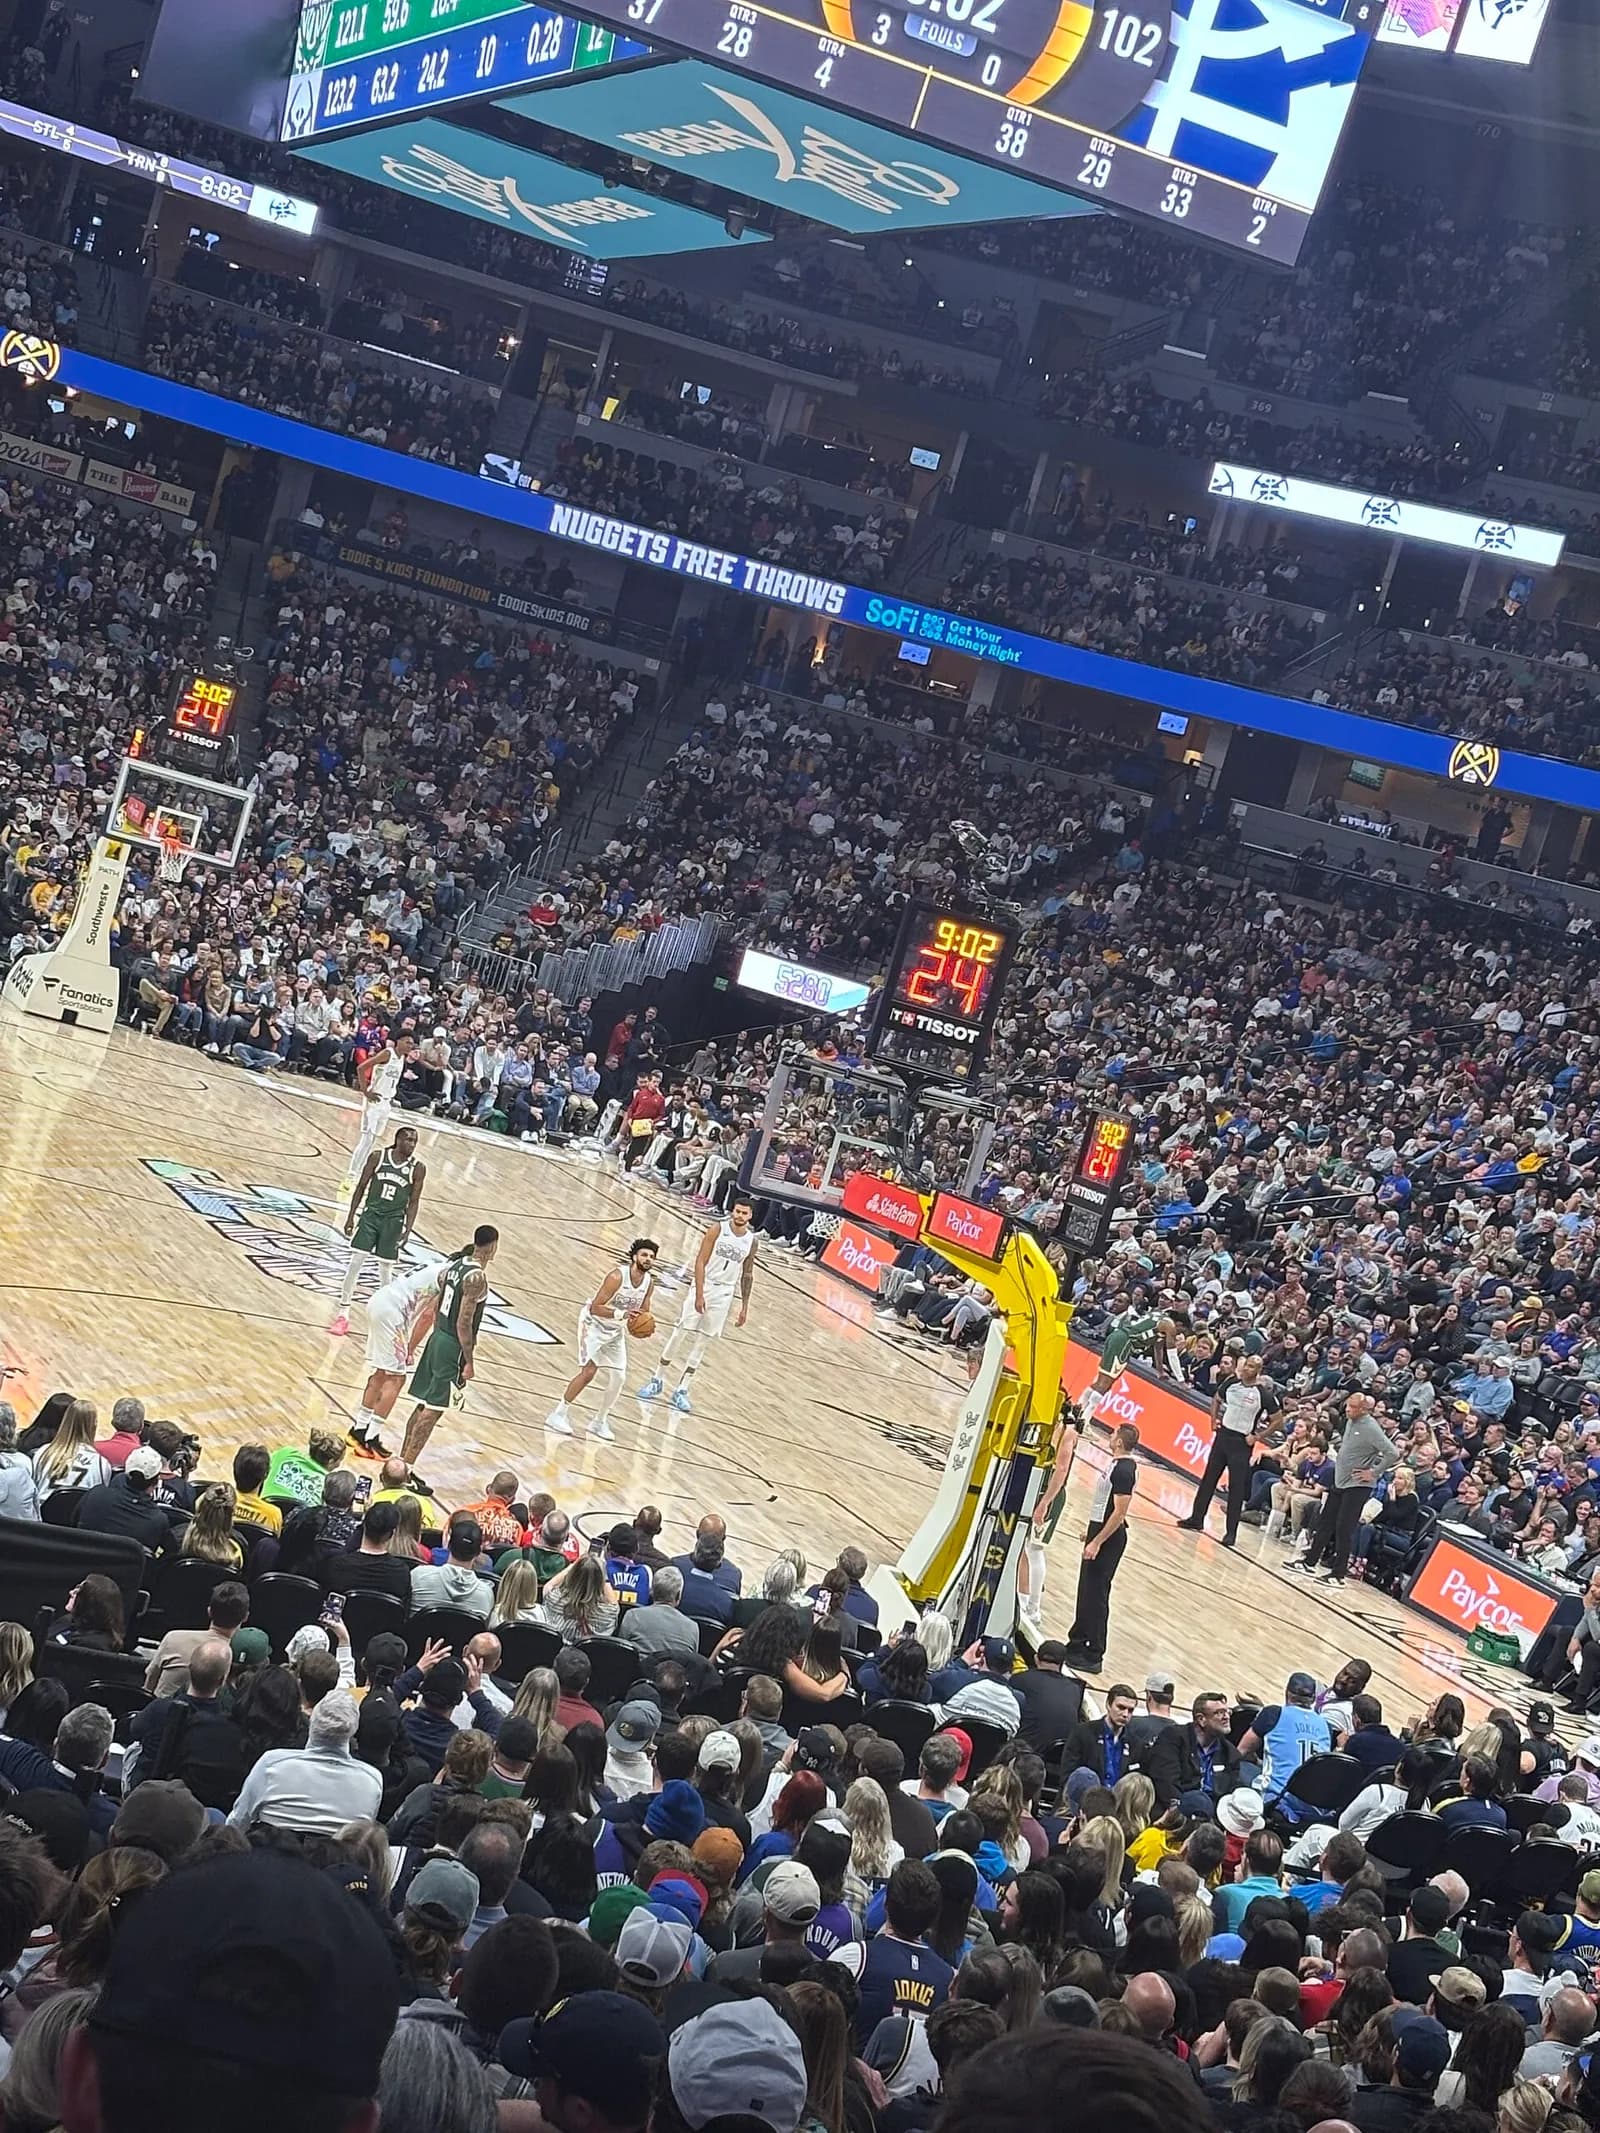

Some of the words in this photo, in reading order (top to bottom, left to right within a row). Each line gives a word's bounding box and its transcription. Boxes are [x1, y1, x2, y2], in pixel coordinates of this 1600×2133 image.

[335, 3, 369, 49] 121.1
[729, 4, 757, 25] QTR3
[871, 13, 893, 45] 3
[1357, 6, 1369, 19] 8
[716, 21, 752, 58] 28
[818, 35, 846, 58] QTR4
[919, 19, 964, 51] FOULS
[1100, 13, 1164, 68] 102
[323, 74, 357, 117] 123.2
[370, 61, 399, 105] 63.2
[417, 48, 450, 93] 24.2
[475, 34, 497, 79] 10
[527, 15, 564, 65] 0.28
[814, 57, 832, 88] 4
[981, 54, 1002, 86] 0
[1006, 105, 1033, 126] QTR1
[1089, 136, 1116, 157] QTR2
[1171, 166, 1198, 187] QTR3
[1251, 195, 1278, 216] QTR4
[995, 122, 1029, 159] 38
[1077, 152, 1112, 189] 29
[1160, 182, 1193, 218] 33
[1246, 214, 1267, 245] 2
[0, 441, 41, 466] oors
[90, 468, 118, 486] THE
[160, 491, 188, 508] BAR
[549, 504, 668, 565] NUGGETS
[673, 537, 738, 585] FREE
[742, 560, 848, 614] THROWS
[338, 547, 384, 572] EDDIE'S
[386, 559, 414, 579] KIDS
[416, 568, 491, 603] FOUNDATION
[497, 592, 591, 632] EDDIESKIDS.ORG
[865, 598, 920, 634] SoFi
[949, 620, 972, 636] Get
[975, 626, 1003, 644] Your
[945, 631, 989, 656] Money
[192, 679, 233, 706] 9:02
[175, 694, 224, 734] 24
[181, 732, 222, 750] TISSOT
[86, 889, 109, 946] Southwest
[934, 920, 999, 964] 9:02
[60, 984, 114, 1008] Fanatics
[775, 963, 833, 1007] 5280
[908, 948, 983, 1015] 24
[916, 1014, 980, 1045] TISSOT
[1088, 1145, 1114, 1178] 24
[381, 1183, 397, 1201] 12
[1079, 1186, 1108, 1206] TISSOT
[945, 1210, 985, 1240] Paycor
[837, 1237, 881, 1275] Paycor
[1100, 1390, 1145, 1422] ycor
[1439, 1568, 1524, 1631] Paycor
